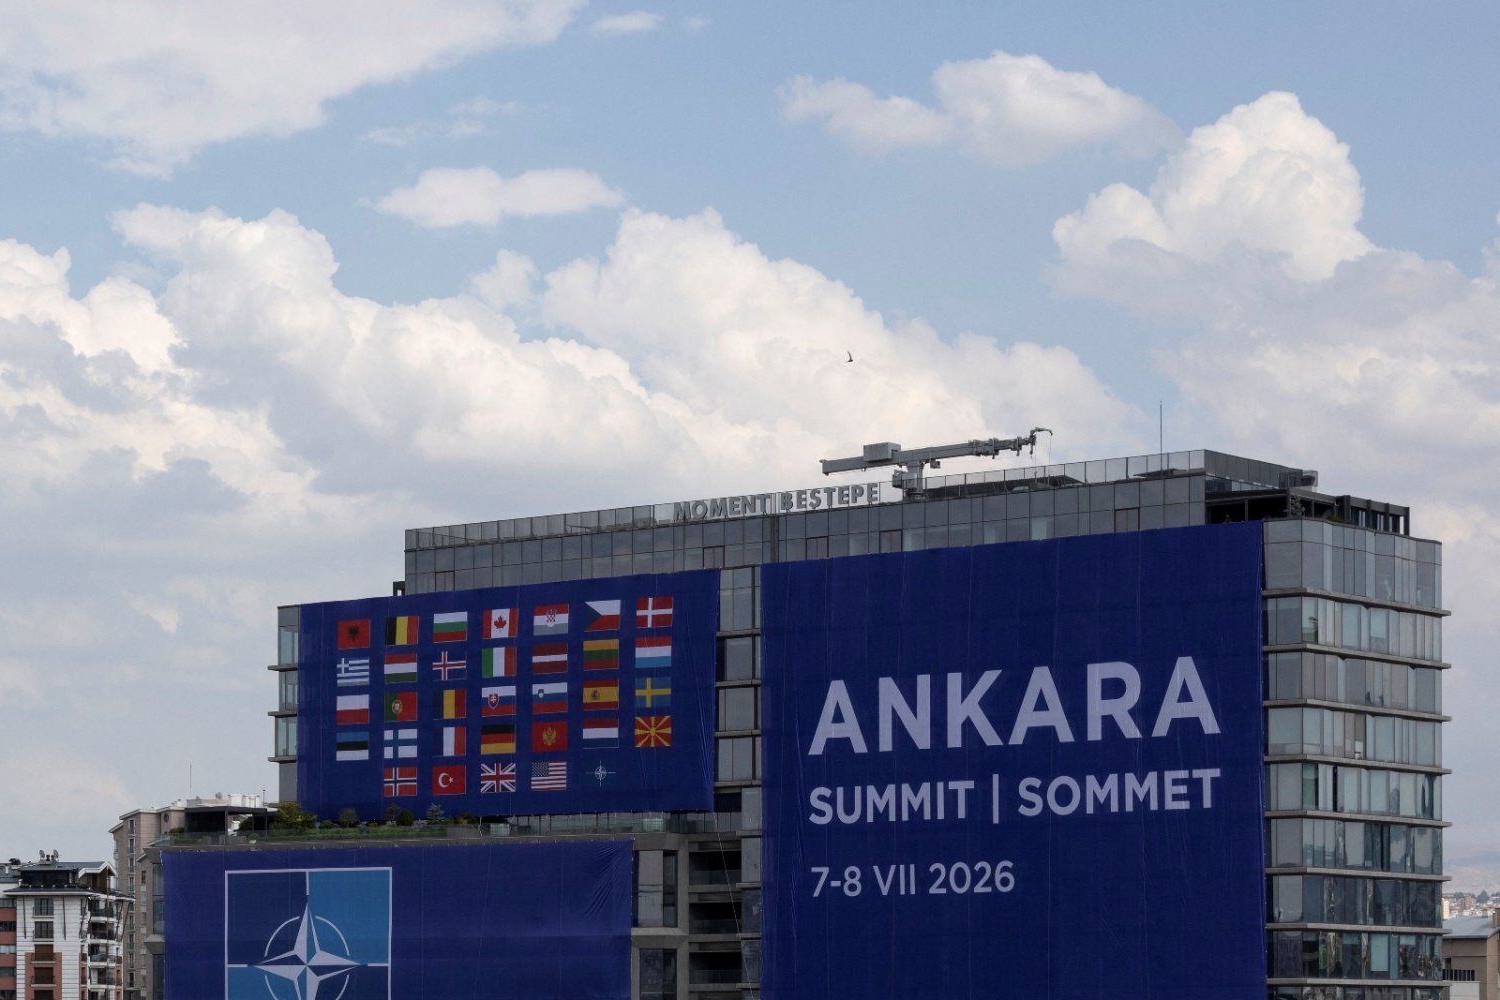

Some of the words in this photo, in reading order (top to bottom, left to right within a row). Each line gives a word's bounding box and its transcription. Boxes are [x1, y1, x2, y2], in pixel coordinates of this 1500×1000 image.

[673, 494, 771, 520] MOMENT
[781, 482, 879, 510] BEŞTEPE
[807, 656, 1221, 755] ANKARA
[808, 780, 975, 825] SUMMIT
[1018, 768, 1221, 817] SOMMET
[810, 865, 862, 898] 7-8
[873, 863, 916, 896] VII
[928, 860, 1016, 895] 2026
